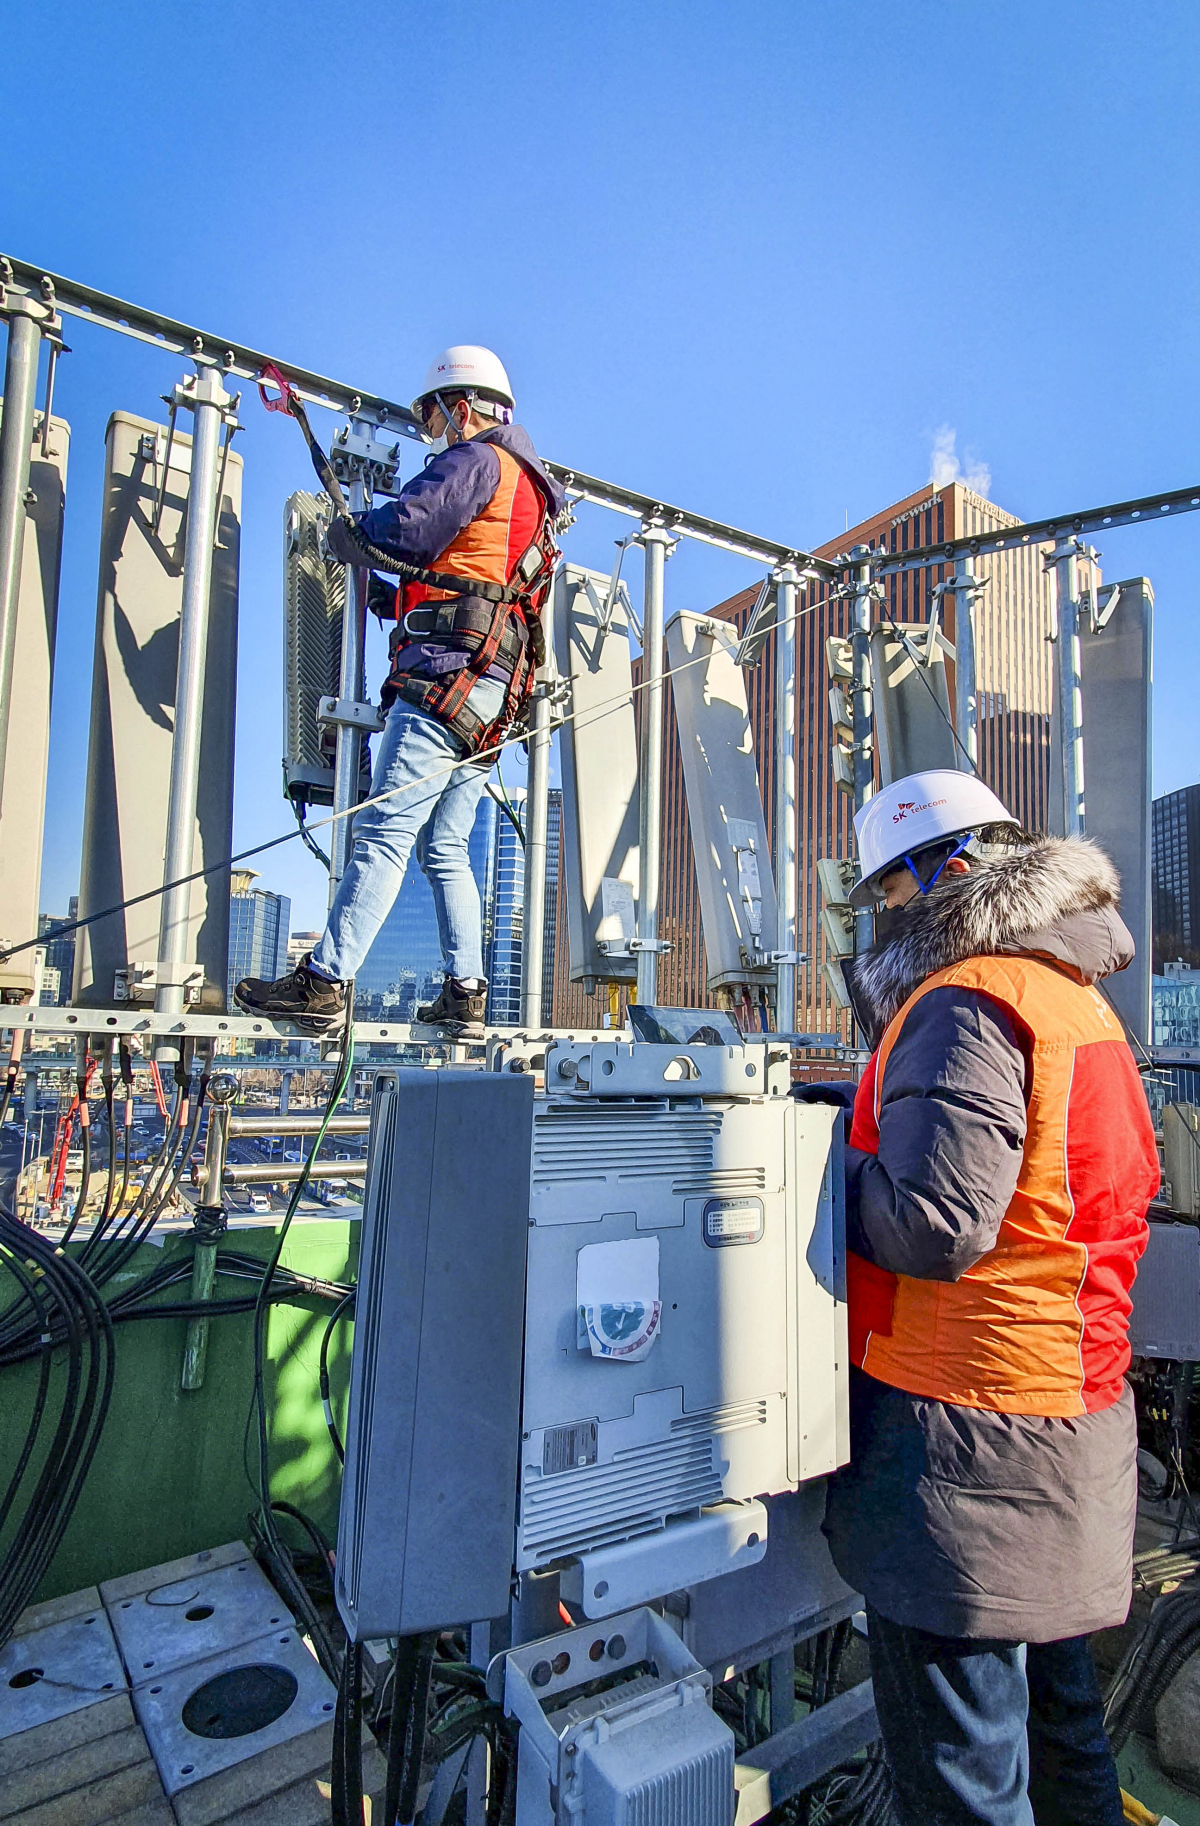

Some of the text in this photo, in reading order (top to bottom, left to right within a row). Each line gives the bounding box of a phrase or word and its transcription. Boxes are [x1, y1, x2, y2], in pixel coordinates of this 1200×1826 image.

[437, 364, 446, 373] SK
[891, 493, 943, 527] wework
[893, 798, 947, 824] SK telecom
